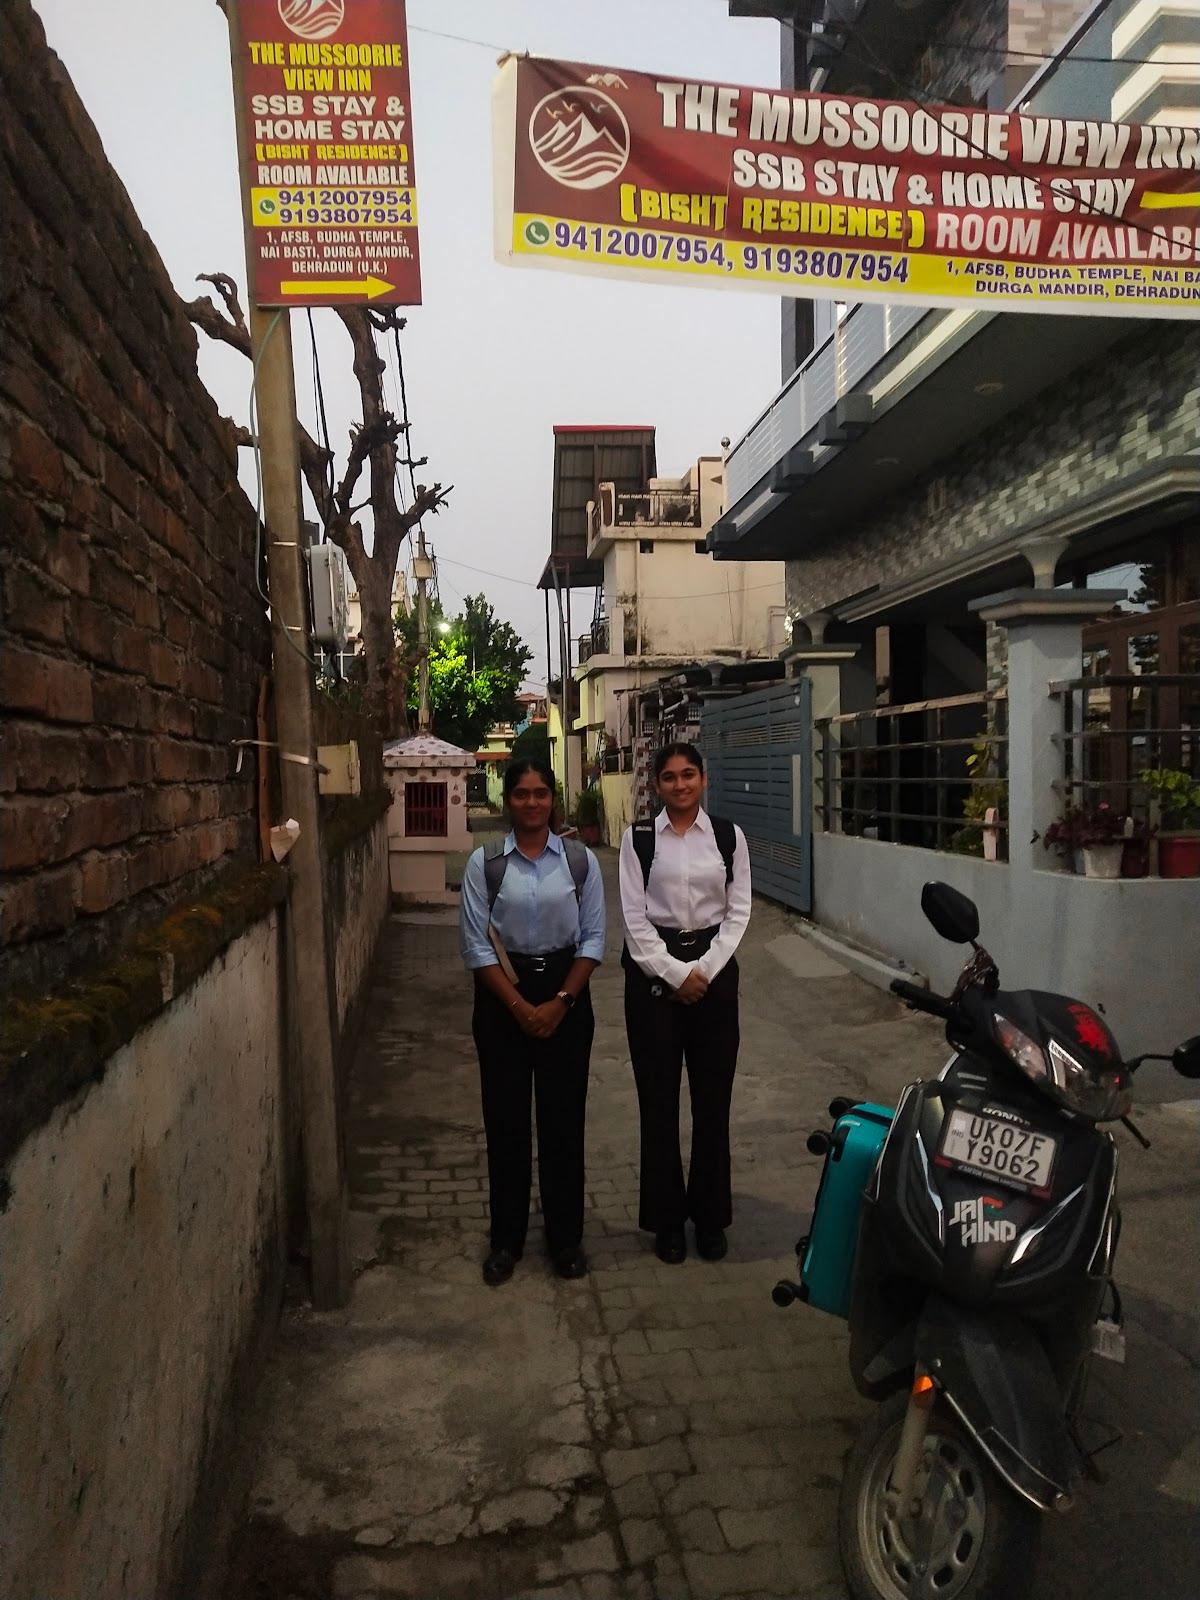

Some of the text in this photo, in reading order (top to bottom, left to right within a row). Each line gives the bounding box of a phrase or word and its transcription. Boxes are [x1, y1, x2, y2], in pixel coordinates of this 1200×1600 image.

[249, 42, 402, 67] THE MUSSOORIE
[283, 69, 372, 91] VIEW INN
[252, 95, 405, 116] SSB STAY &
[255, 120, 405, 140] HOME STAY
[656, 81, 1200, 170] THE MUSSOORIE VIEW INN
[258, 165, 408, 185] ROOM AVAILABLE
[733, 148, 1135, 219] SSB STAY & HOME STAY
[278, 190, 412, 206] 9412007954
[279, 208, 412, 224] 9193807954
[267, 231, 407, 245] 1, AFSB, BUDHA TEMPLE,
[936, 212, 1042, 257] ROOM
[260, 246, 414, 260] NAI BASTI, DURGA MANDIR,
[555, 221, 909, 283] 9412007954, 9193807954
[292, 261, 388, 275] DEHRADUN (U.K.)
[947, 261, 959, 276] 1,
[964, 262, 1009, 279] AFSB,
[1015, 265, 1072, 280] BUDHA
[1077, 267, 1147, 284] TEMPLE,
[1152, 270, 1179, 282] NAI
[976, 280, 1200, 300] DURGA MANDIR, DEHRADUN
[970, 1117, 1046, 1156] UK07F
[967, 1139, 1040, 1182] Y9062
[948, 1196, 984, 1226] JAI
[961, 1220, 1017, 1248] HIND
